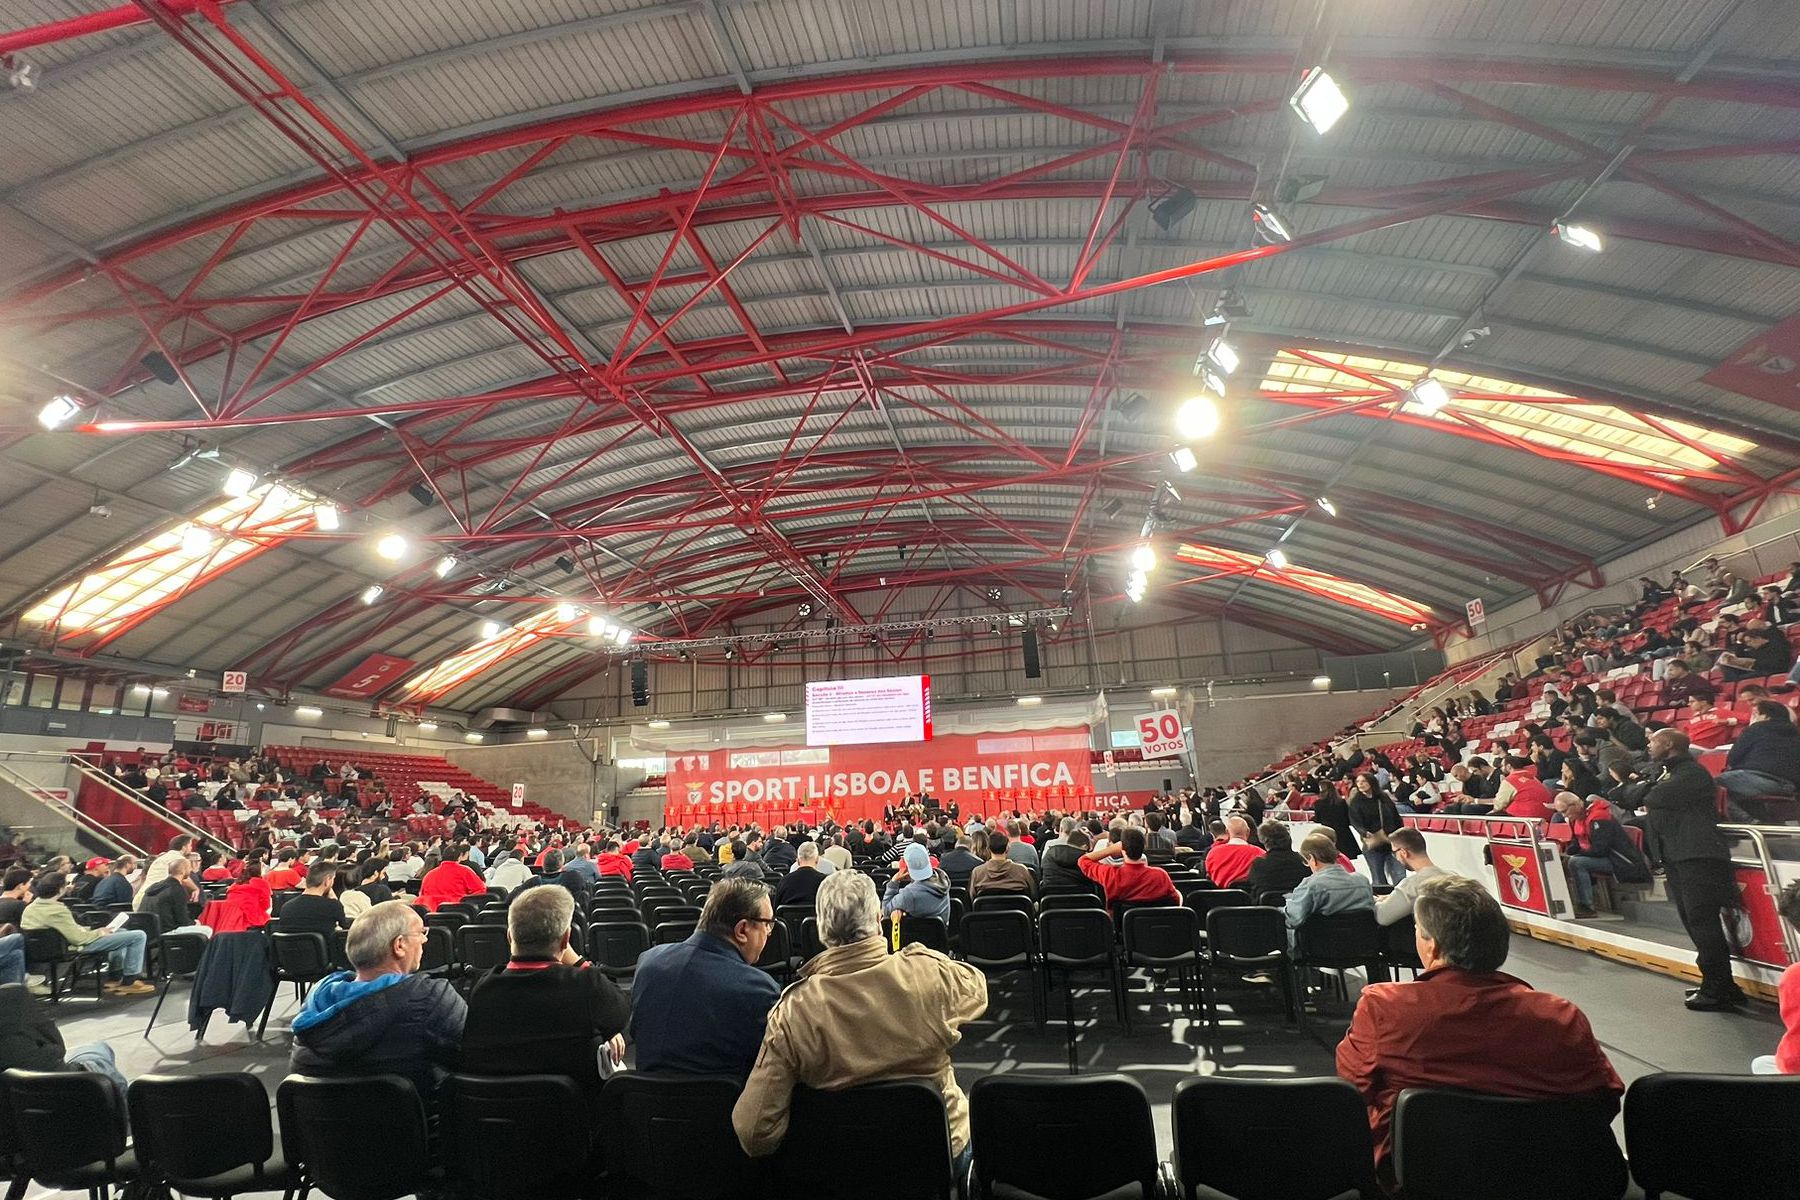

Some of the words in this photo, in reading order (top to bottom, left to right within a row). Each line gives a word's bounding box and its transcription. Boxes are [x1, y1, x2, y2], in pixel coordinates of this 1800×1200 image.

[1468, 601, 1482, 617] 50
[225, 674, 244, 685] 20
[1139, 714, 1179, 743] 50
[1145, 740, 1184, 754] VOTOS
[709, 776, 801, 804] SPORT
[808, 769, 911, 799] LISBOA
[918, 769, 934, 792] E
[943, 762, 1074, 791] BENFICA
